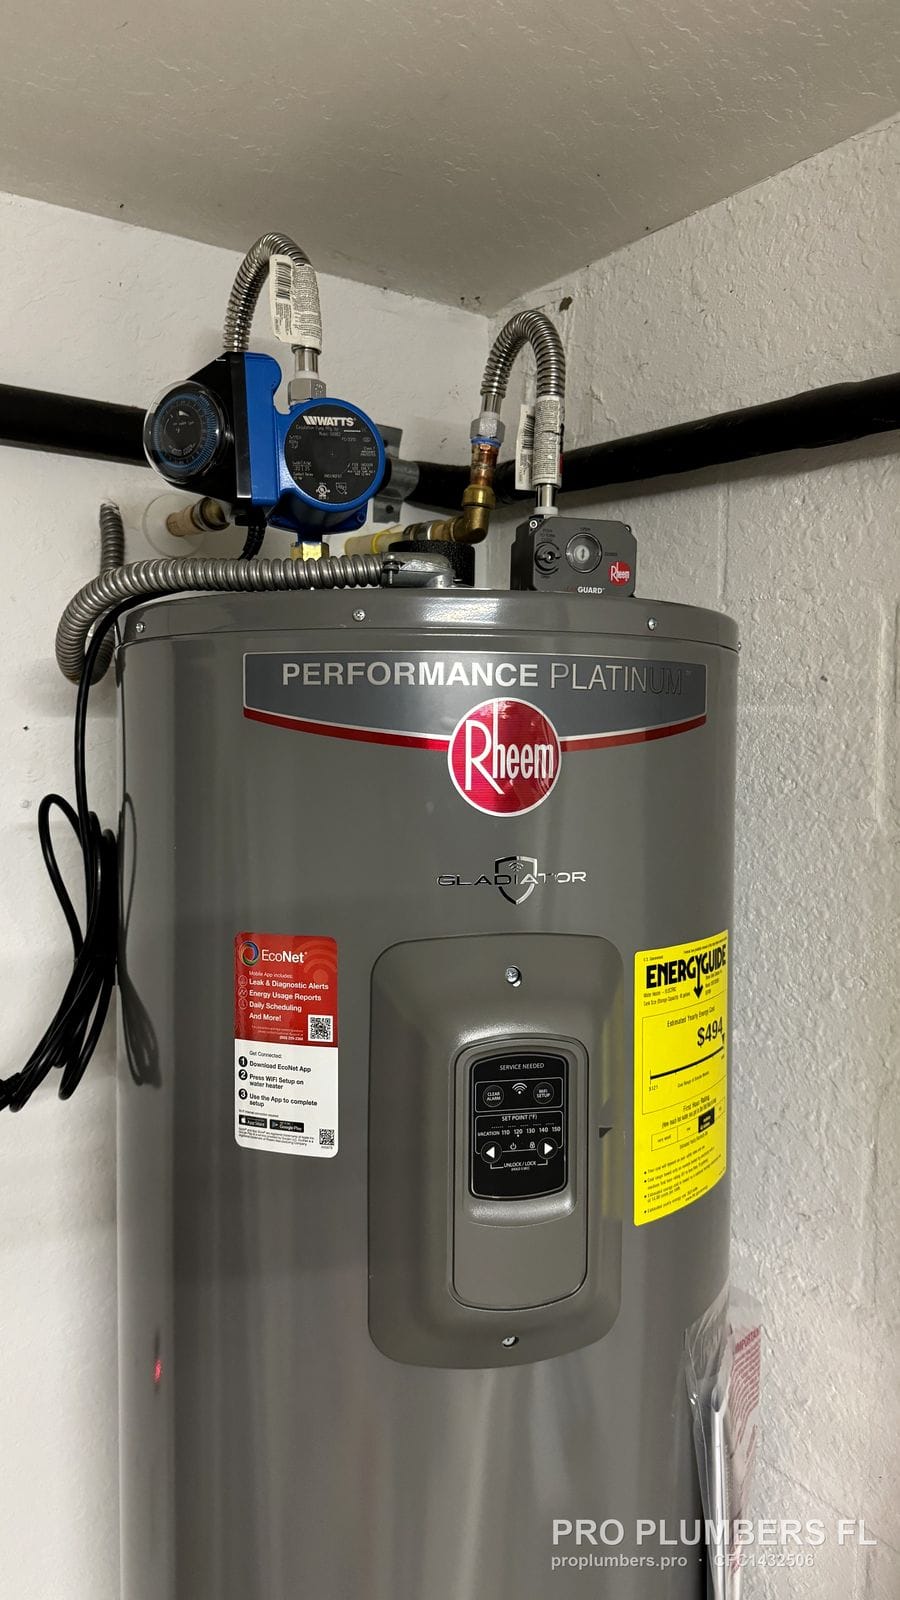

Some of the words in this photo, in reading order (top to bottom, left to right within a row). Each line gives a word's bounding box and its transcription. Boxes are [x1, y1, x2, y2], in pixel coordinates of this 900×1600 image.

[303, 415, 355, 427] WATTS
[577, 586, 603, 594] GUARD
[282, 661, 539, 687] PERFORMANCE
[550, 663, 682, 695] PLATINUM
[464, 699, 554, 795] Rheem
[436, 871, 587, 887] GLADIATOR
[261, 949, 305, 964] EcoNet
[646, 944, 726, 990] ENERGYGUIDE
[249, 978, 264, 986] Leak
[271, 980, 307, 990] Diagnostic
[308, 982, 329, 990] Alerts
[249, 990, 271, 999] Energy
[272, 992, 293, 1000] Usage
[294, 993, 322, 1001] Reports
[249, 1001, 265, 1010] Daily
[266, 1002, 302, 1013] Scheduling
[263, 1013, 282, 1021] More!
[249, 1060, 277, 1069] Download
[277, 1064, 298, 1072] EcoNet
[499, 1063, 521, 1071] SERVICE
[249, 1073, 265, 1081] Press
[279, 1077, 295, 1085] Setup
[265, 1082, 283, 1090] heater
